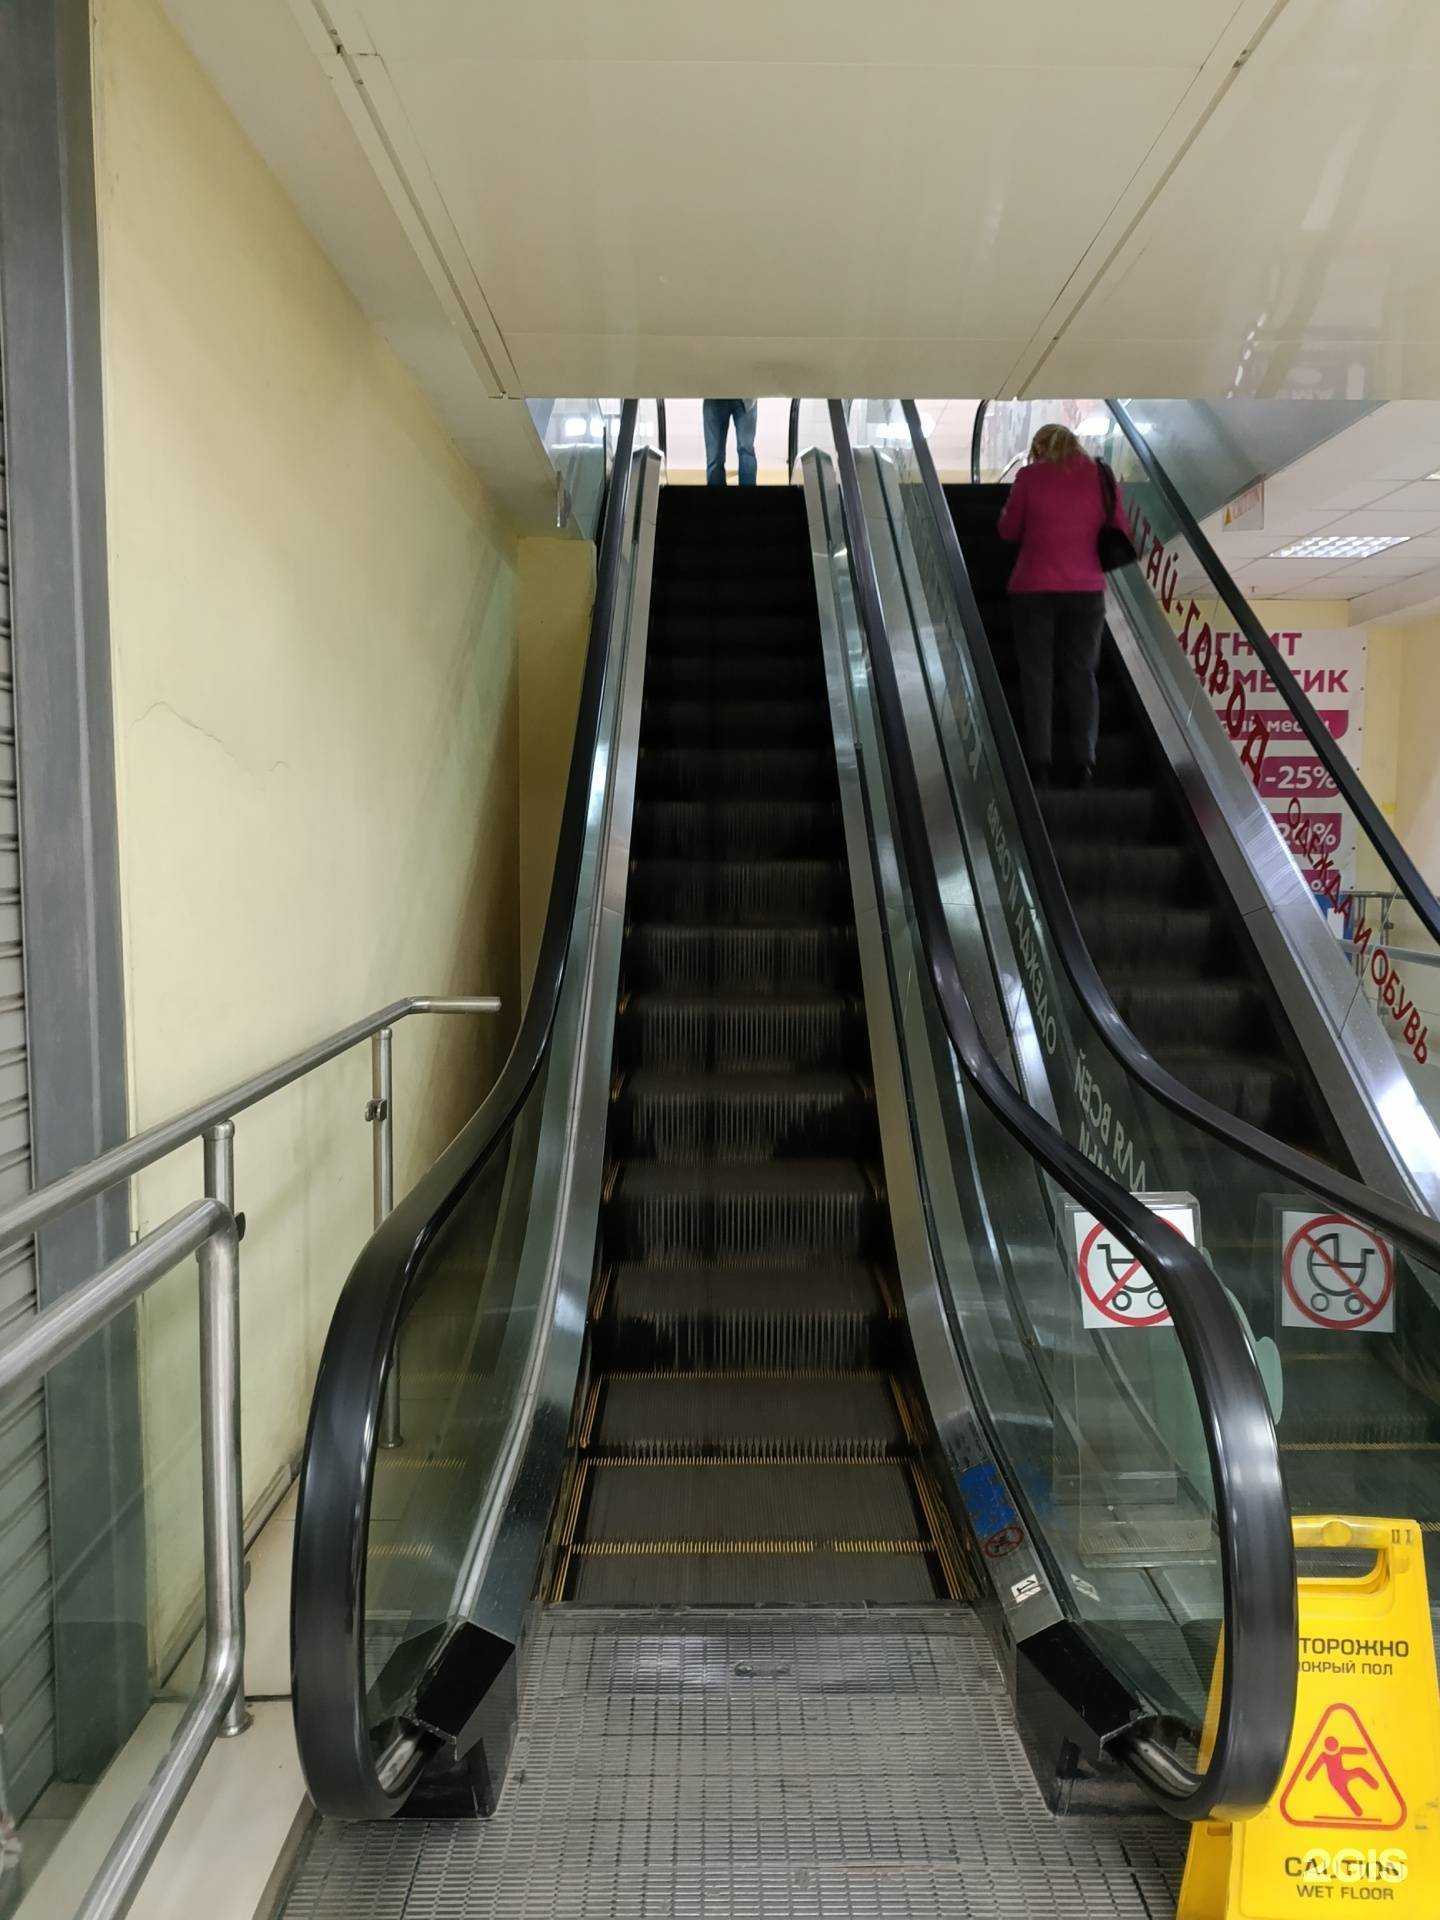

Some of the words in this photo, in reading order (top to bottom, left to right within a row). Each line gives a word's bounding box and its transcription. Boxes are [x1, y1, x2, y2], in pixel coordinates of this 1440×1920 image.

[1127, 496, 1270, 788] ИТАЙ-ГОРОД
[1265, 766, 1338, 789] -25%
[1298, 1637, 1409, 1658] ТОРОЖНО
[1298, 1660, 1356, 1674] ОКРЫЙ
[1361, 1662, 1393, 1676] ПОЛ
[1297, 1884, 1334, 1899] WET
[1340, 1886, 1394, 1900] FLOOR
